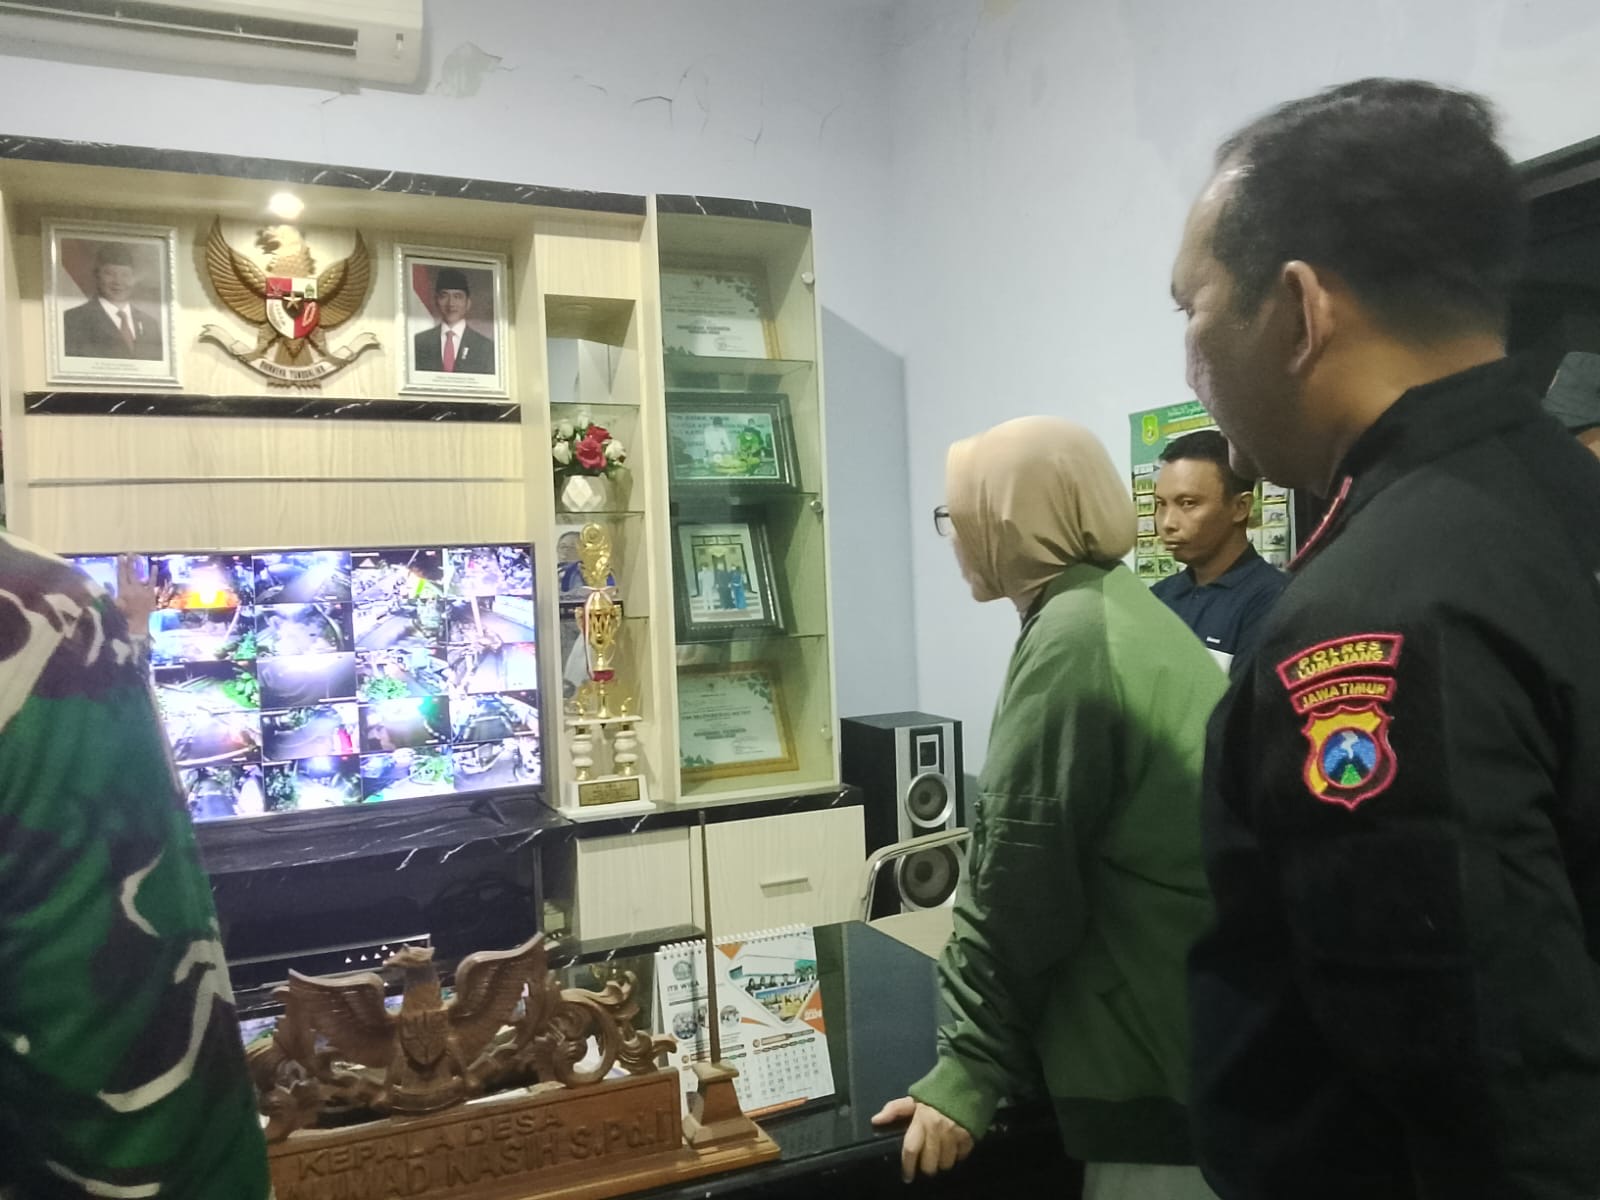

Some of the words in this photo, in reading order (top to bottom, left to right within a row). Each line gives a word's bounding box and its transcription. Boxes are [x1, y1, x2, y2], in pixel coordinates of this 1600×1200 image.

[1298, 641, 1380, 669] POLRES
[1298, 650, 1384, 679] LUMAJANG
[1303, 685, 1339, 708] JAWA
[1339, 682, 1386, 695] TIMUR
[298, 1132, 455, 1181] KEPALA
[464, 1109, 563, 1147] DESA
[447, 1129, 559, 1188] NASIH
